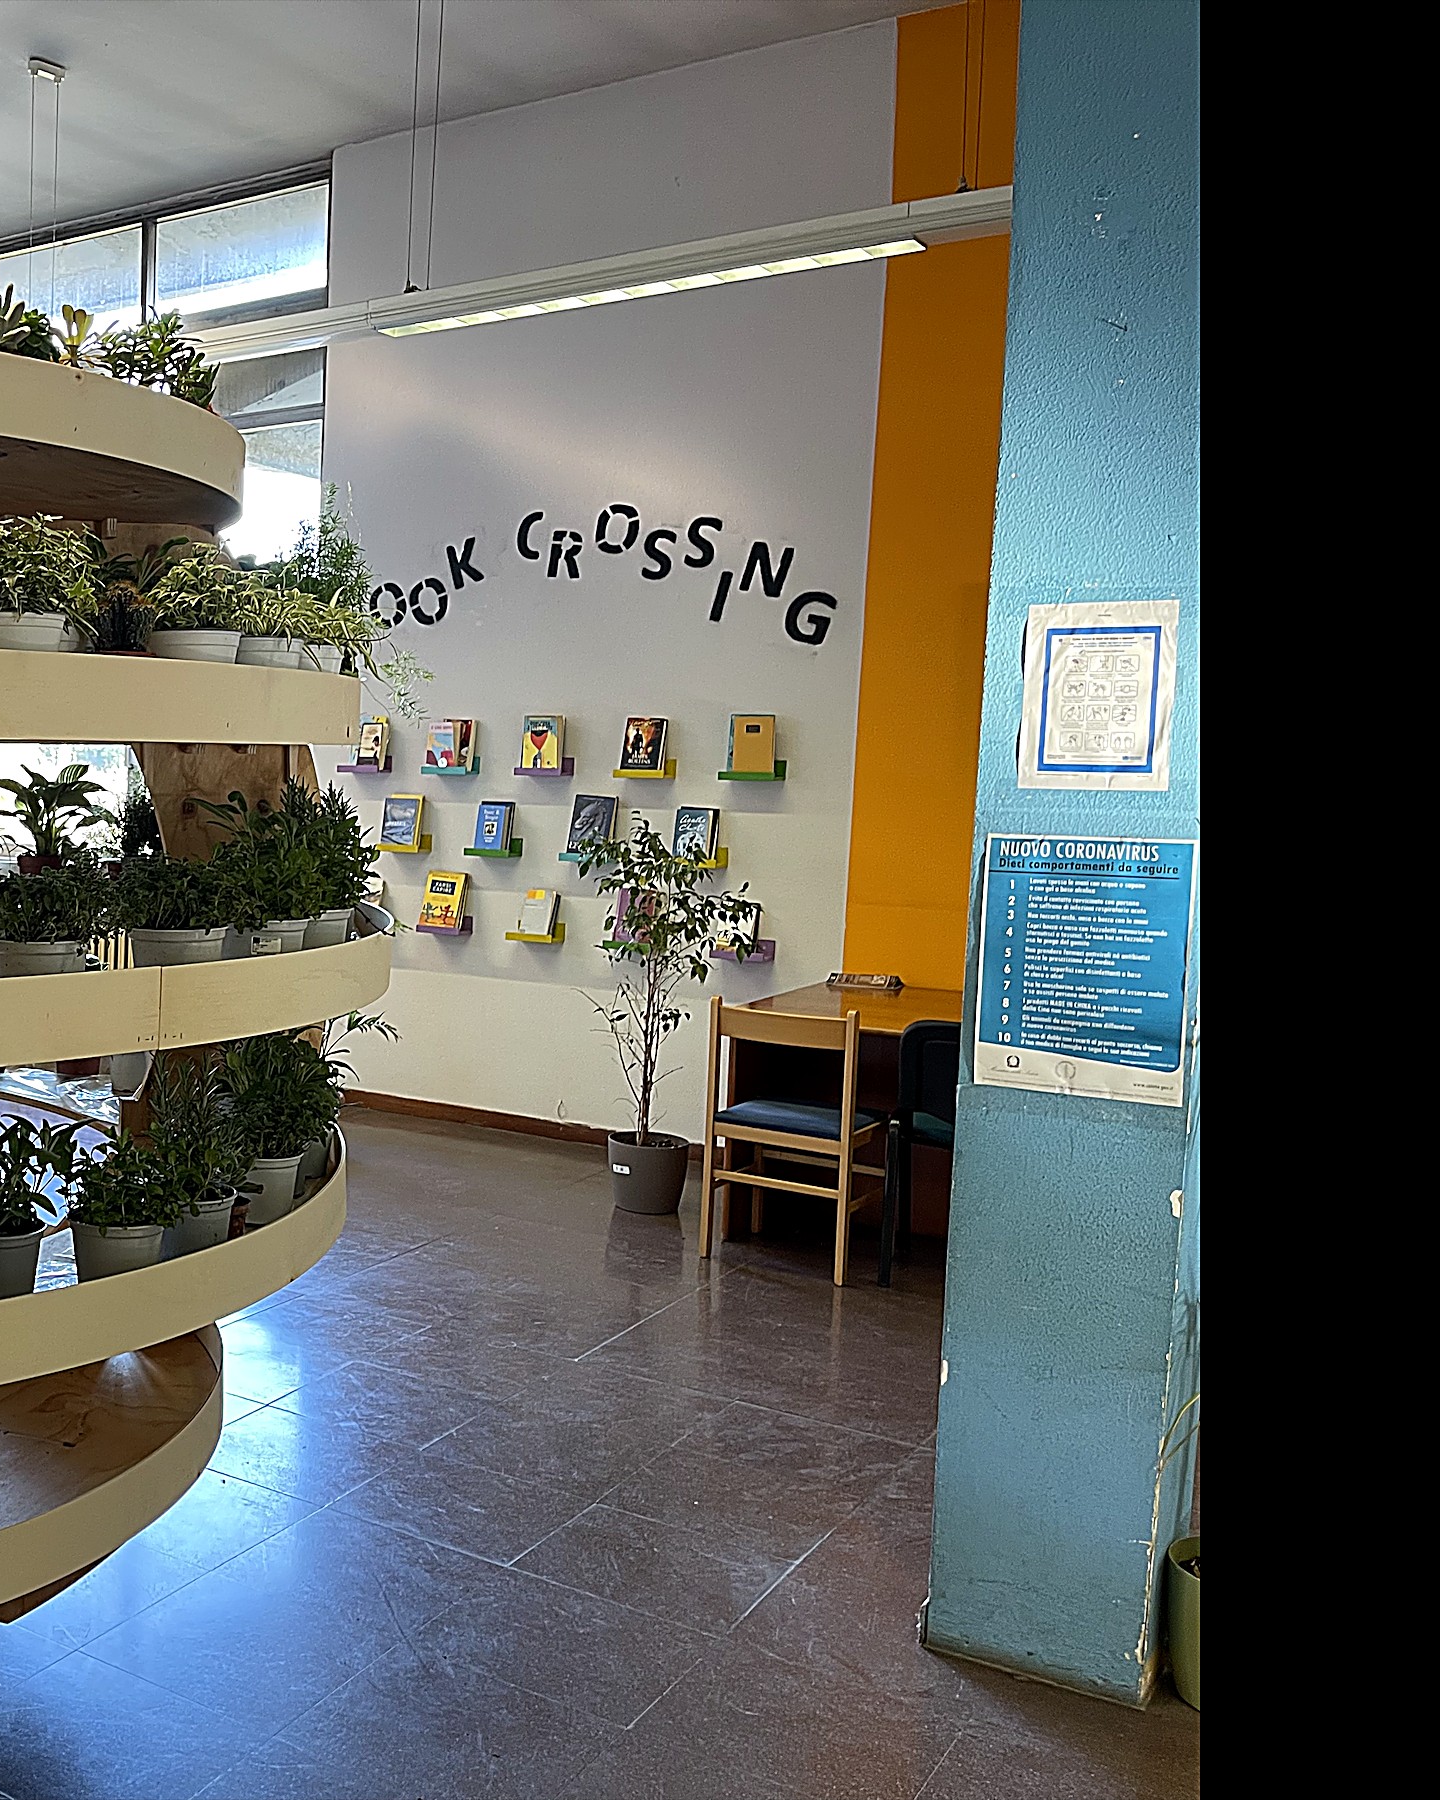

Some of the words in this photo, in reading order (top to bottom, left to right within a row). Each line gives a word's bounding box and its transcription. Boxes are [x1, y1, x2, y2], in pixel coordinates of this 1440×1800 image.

[369, 536, 485, 628] OOK
[517, 503, 838, 646] CROSSING
[1000, 840, 1051, 858] NUOVO
[1056, 842, 1160, 862] CORONAVIRUS
[999, 857, 1025, 868] Dieci
[1028, 860, 1115, 872] comportamenti
[1118, 861, 1132, 872] da
[1136, 864, 1179, 875] seguire
[1010, 878, 1015, 889] 1
[1008, 895, 1016, 906] 2
[1007, 909, 1015, 920] 3
[1006, 926, 1013, 937] 4
[1004, 947, 1012, 958] 5
[1003, 963, 1011, 974] 6
[1003, 980, 1011, 991] 7
[1002, 997, 1010, 1008] 8
[1001, 1014, 1009, 1025] 9
[998, 1031, 1011, 1043] 10
